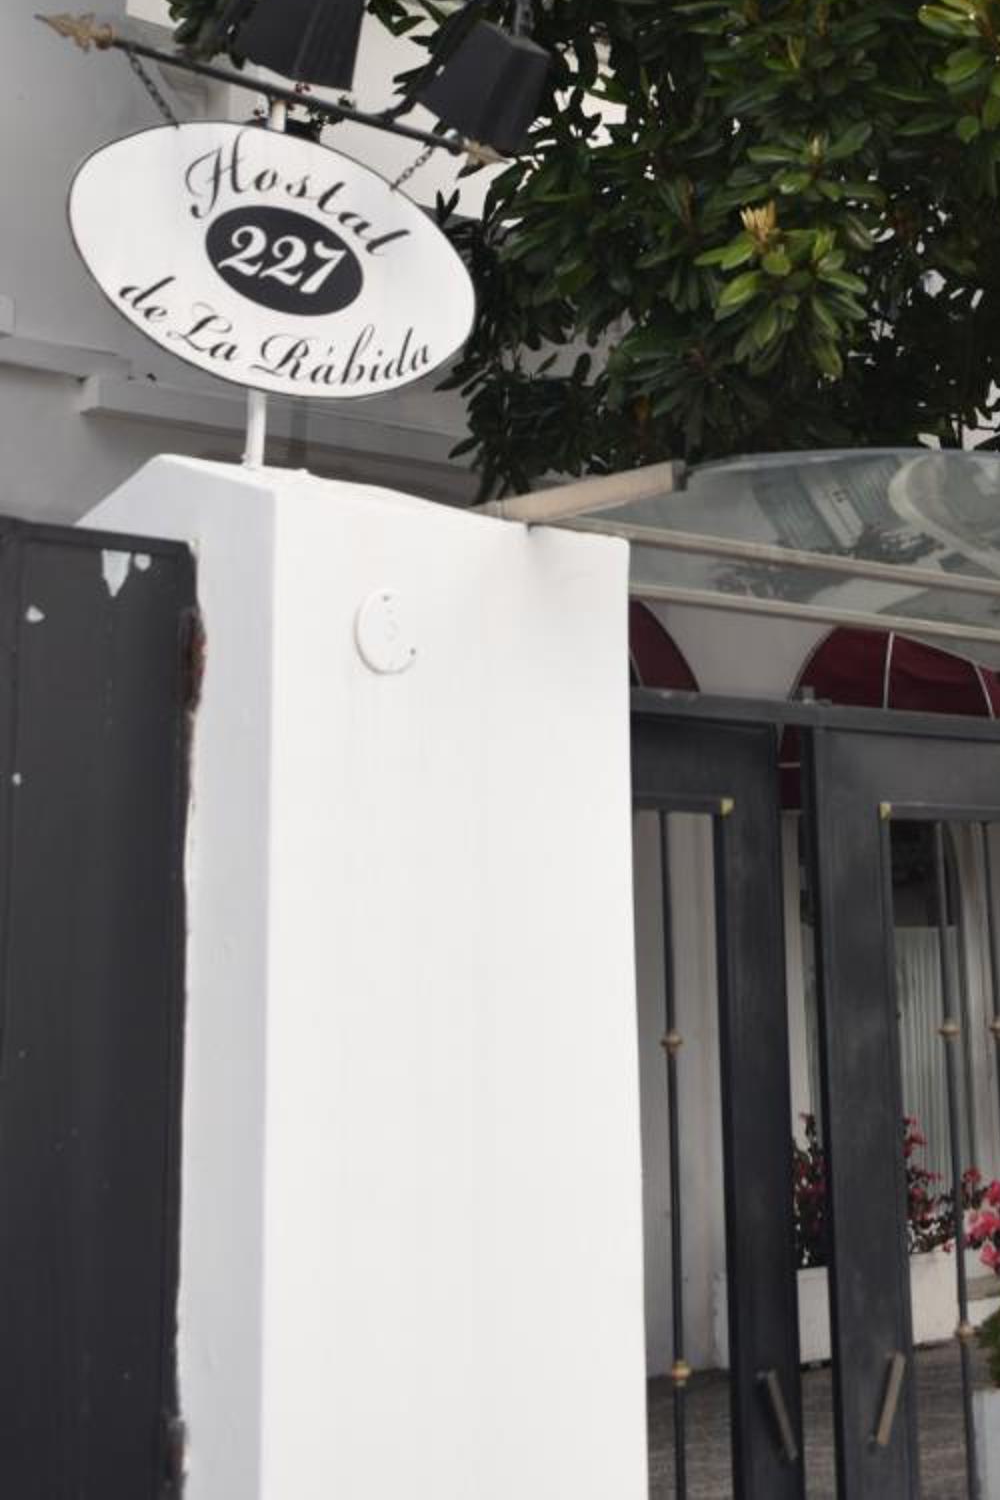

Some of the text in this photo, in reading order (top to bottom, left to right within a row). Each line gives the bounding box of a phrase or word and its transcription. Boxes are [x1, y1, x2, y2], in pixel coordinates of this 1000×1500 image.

[185, 129, 410, 256] Hostal
[218, 225, 346, 294] 227
[119, 276, 430, 385] de La Rábida
